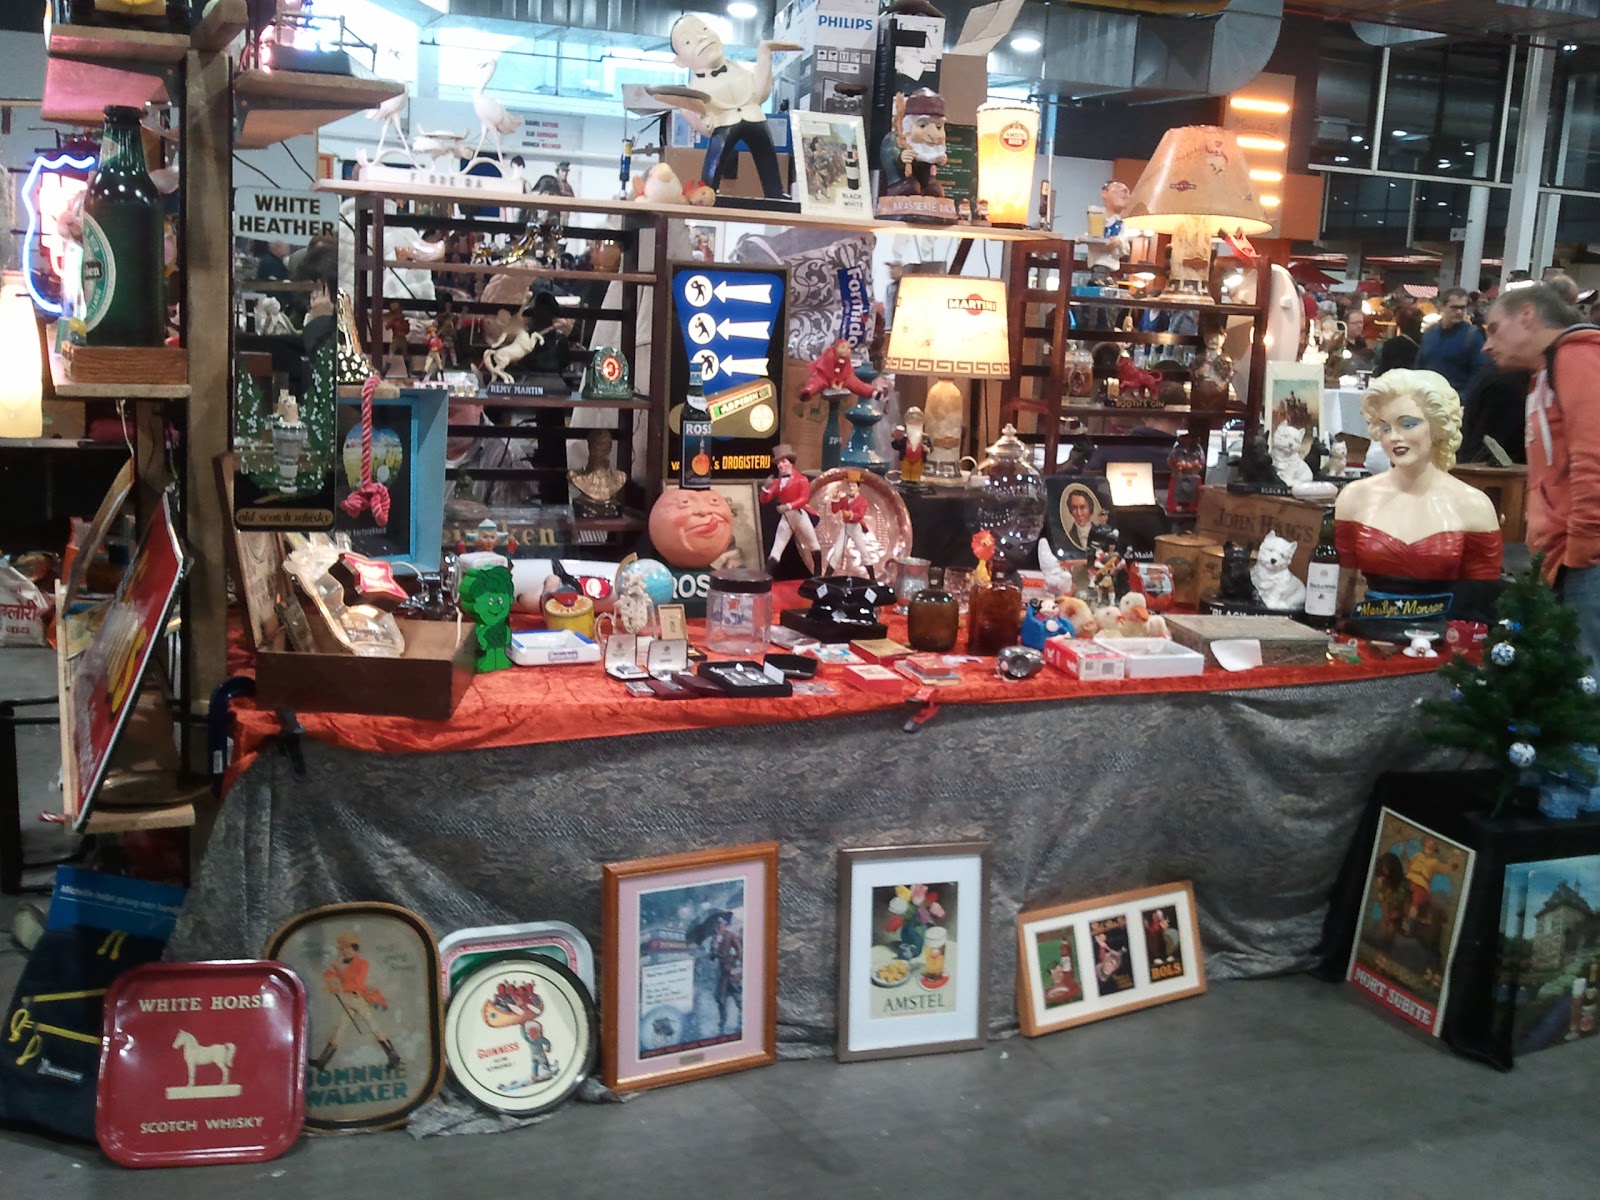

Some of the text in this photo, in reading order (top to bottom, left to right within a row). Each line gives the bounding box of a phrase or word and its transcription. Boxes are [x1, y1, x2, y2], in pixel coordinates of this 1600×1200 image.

[818, 15, 873, 31] PHILIPS
[254, 194, 320, 214] WHITE
[893, 201, 937, 212] BRASSERIE
[239, 215, 335, 236] HEATHER
[846, 266, 864, 349] Formido
[947, 298, 997, 312] MARTINI
[490, 384, 544, 396] REMY MARTIN
[719, 392, 760, 415] ASPIRIN
[238, 509, 331, 524] old scotch whisky
[1215, 508, 1256, 534] JOHN
[1360, 599, 1444, 618] Marilyn Monroe
[1151, 962, 1181, 980] BOLS
[138, 997, 203, 1013] WHITE
[882, 993, 945, 1013] AMSTEL
[1354, 967, 1433, 1026] MORT SUBITE
[477, 1042, 519, 1060] GUINNESS
[306, 1081, 408, 1108] WALKER
[139, 1116, 265, 1135] SCOTCH WHISKY
